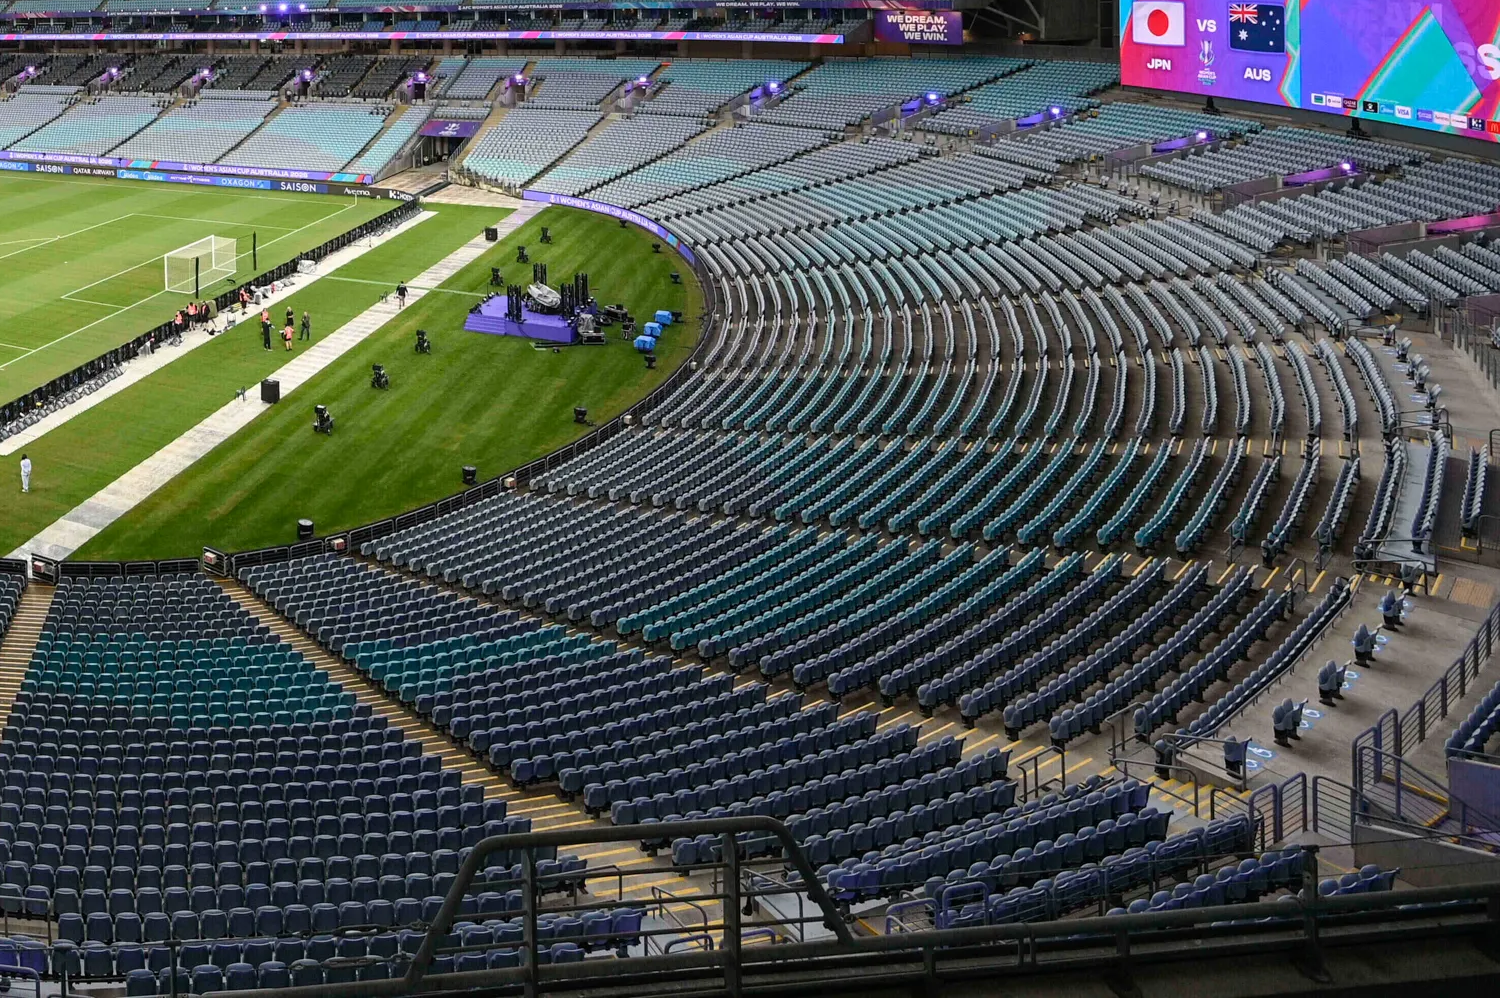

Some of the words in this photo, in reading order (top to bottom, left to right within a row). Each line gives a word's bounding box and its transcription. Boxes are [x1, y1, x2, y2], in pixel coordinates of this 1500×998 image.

[905, 16, 947, 24] DREAM.
[899, 24, 915, 32] WE
[916, 24, 947, 32] PLAY.
[1196, 19, 1217, 32] VS
[923, 32, 947, 41] WIN.
[1147, 58, 1171, 70] JPN
[1244, 67, 1271, 81] AUS
[1396, 108, 1409, 116] VISA
[251, 168, 289, 178] AUSTRALIA
[221, 179, 255, 187] OXAGON
[280, 182, 316, 192] SAISON
[560, 197, 591, 209] WOMEN'S
[592, 203, 610, 213] ASIAN
